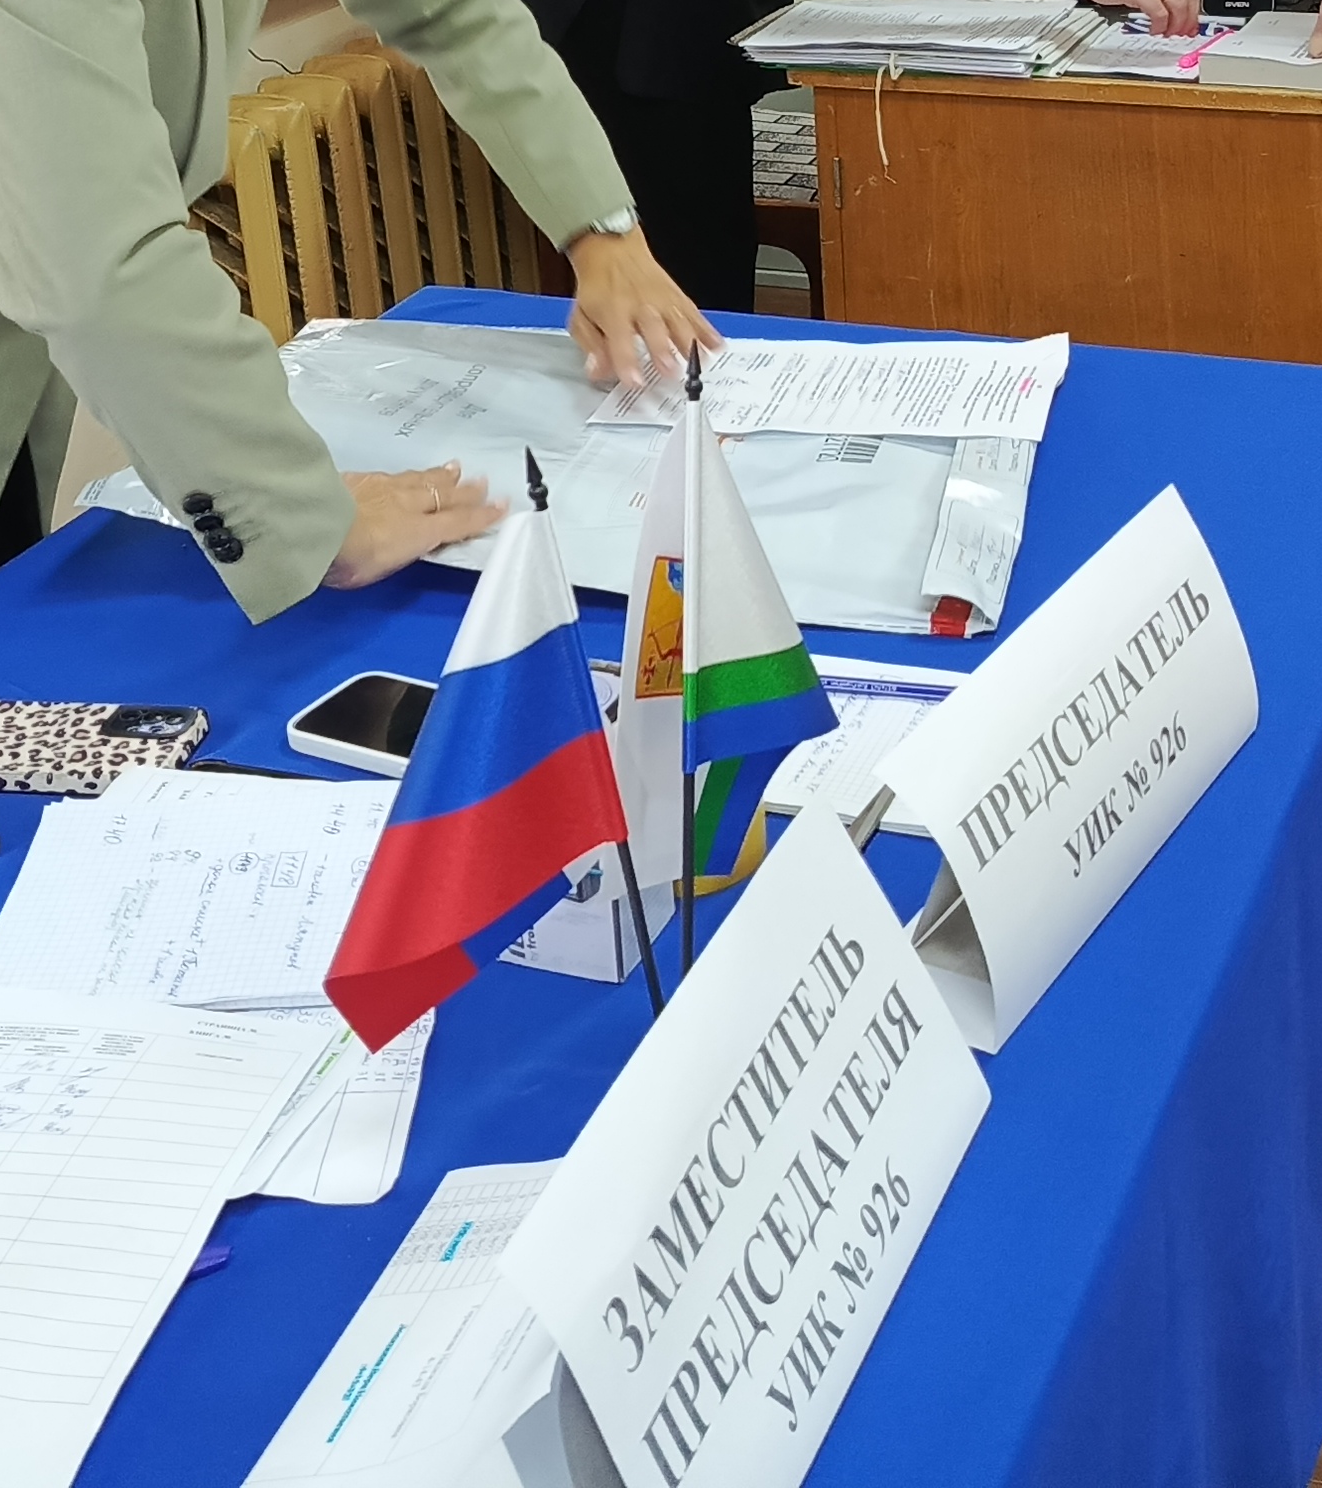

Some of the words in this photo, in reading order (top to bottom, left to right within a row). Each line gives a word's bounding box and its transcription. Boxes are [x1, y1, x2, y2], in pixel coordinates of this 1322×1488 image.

[958, 579, 1211, 870] ПРЕДСЕДАТЕЛЬ
[1062, 804, 1120, 877] УИК
[1122, 766, 1152, 800] №
[1149, 712, 1187, 763] 926
[602, 926, 866, 1373] ЗАМЕСТИТЕЛЬ
[640, 979, 924, 1488] ПРЕДСЕДАТЕЛЯ
[765, 1292, 843, 1431] УИК
[839, 1243, 875, 1292] №
[869, 1157, 912, 1243] 926
